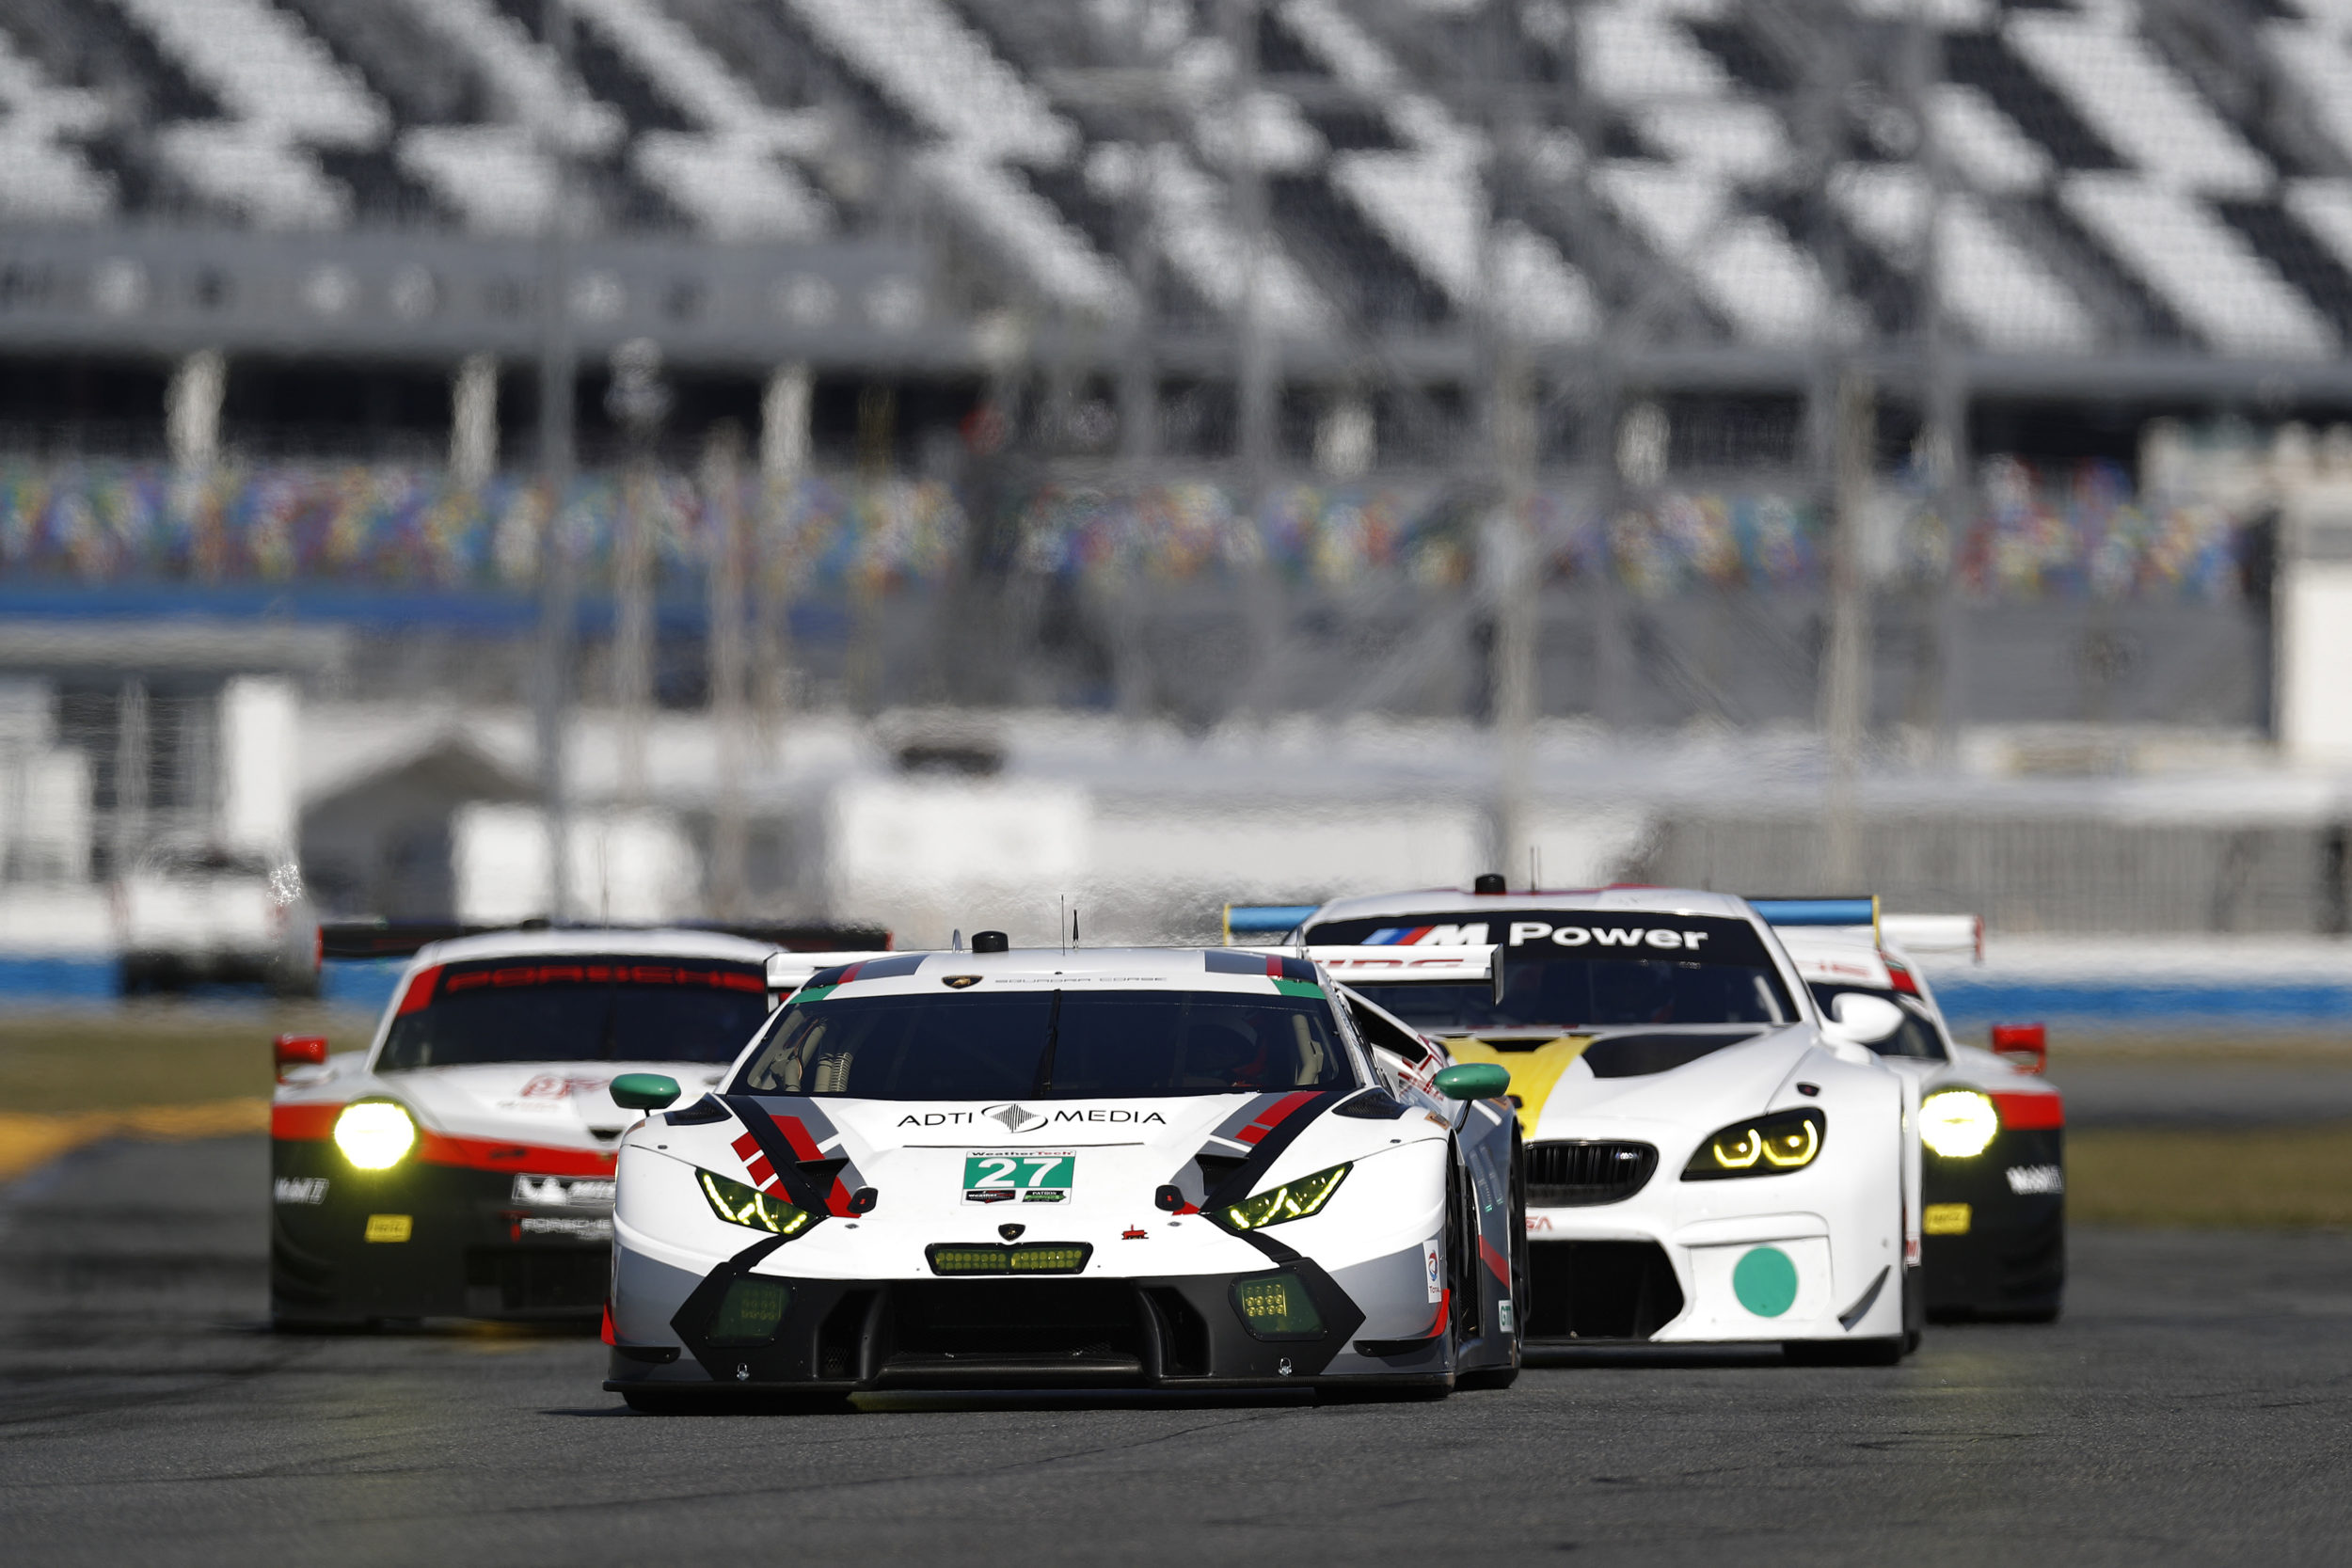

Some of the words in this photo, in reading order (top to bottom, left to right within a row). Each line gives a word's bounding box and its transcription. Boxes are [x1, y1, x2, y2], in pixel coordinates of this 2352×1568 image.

[1508, 922, 1708, 951] Power
[897, 1112, 973, 1128] ADTI
[1054, 1110, 1167, 1125] MEDIA
[974, 1157, 1063, 1188] 27
